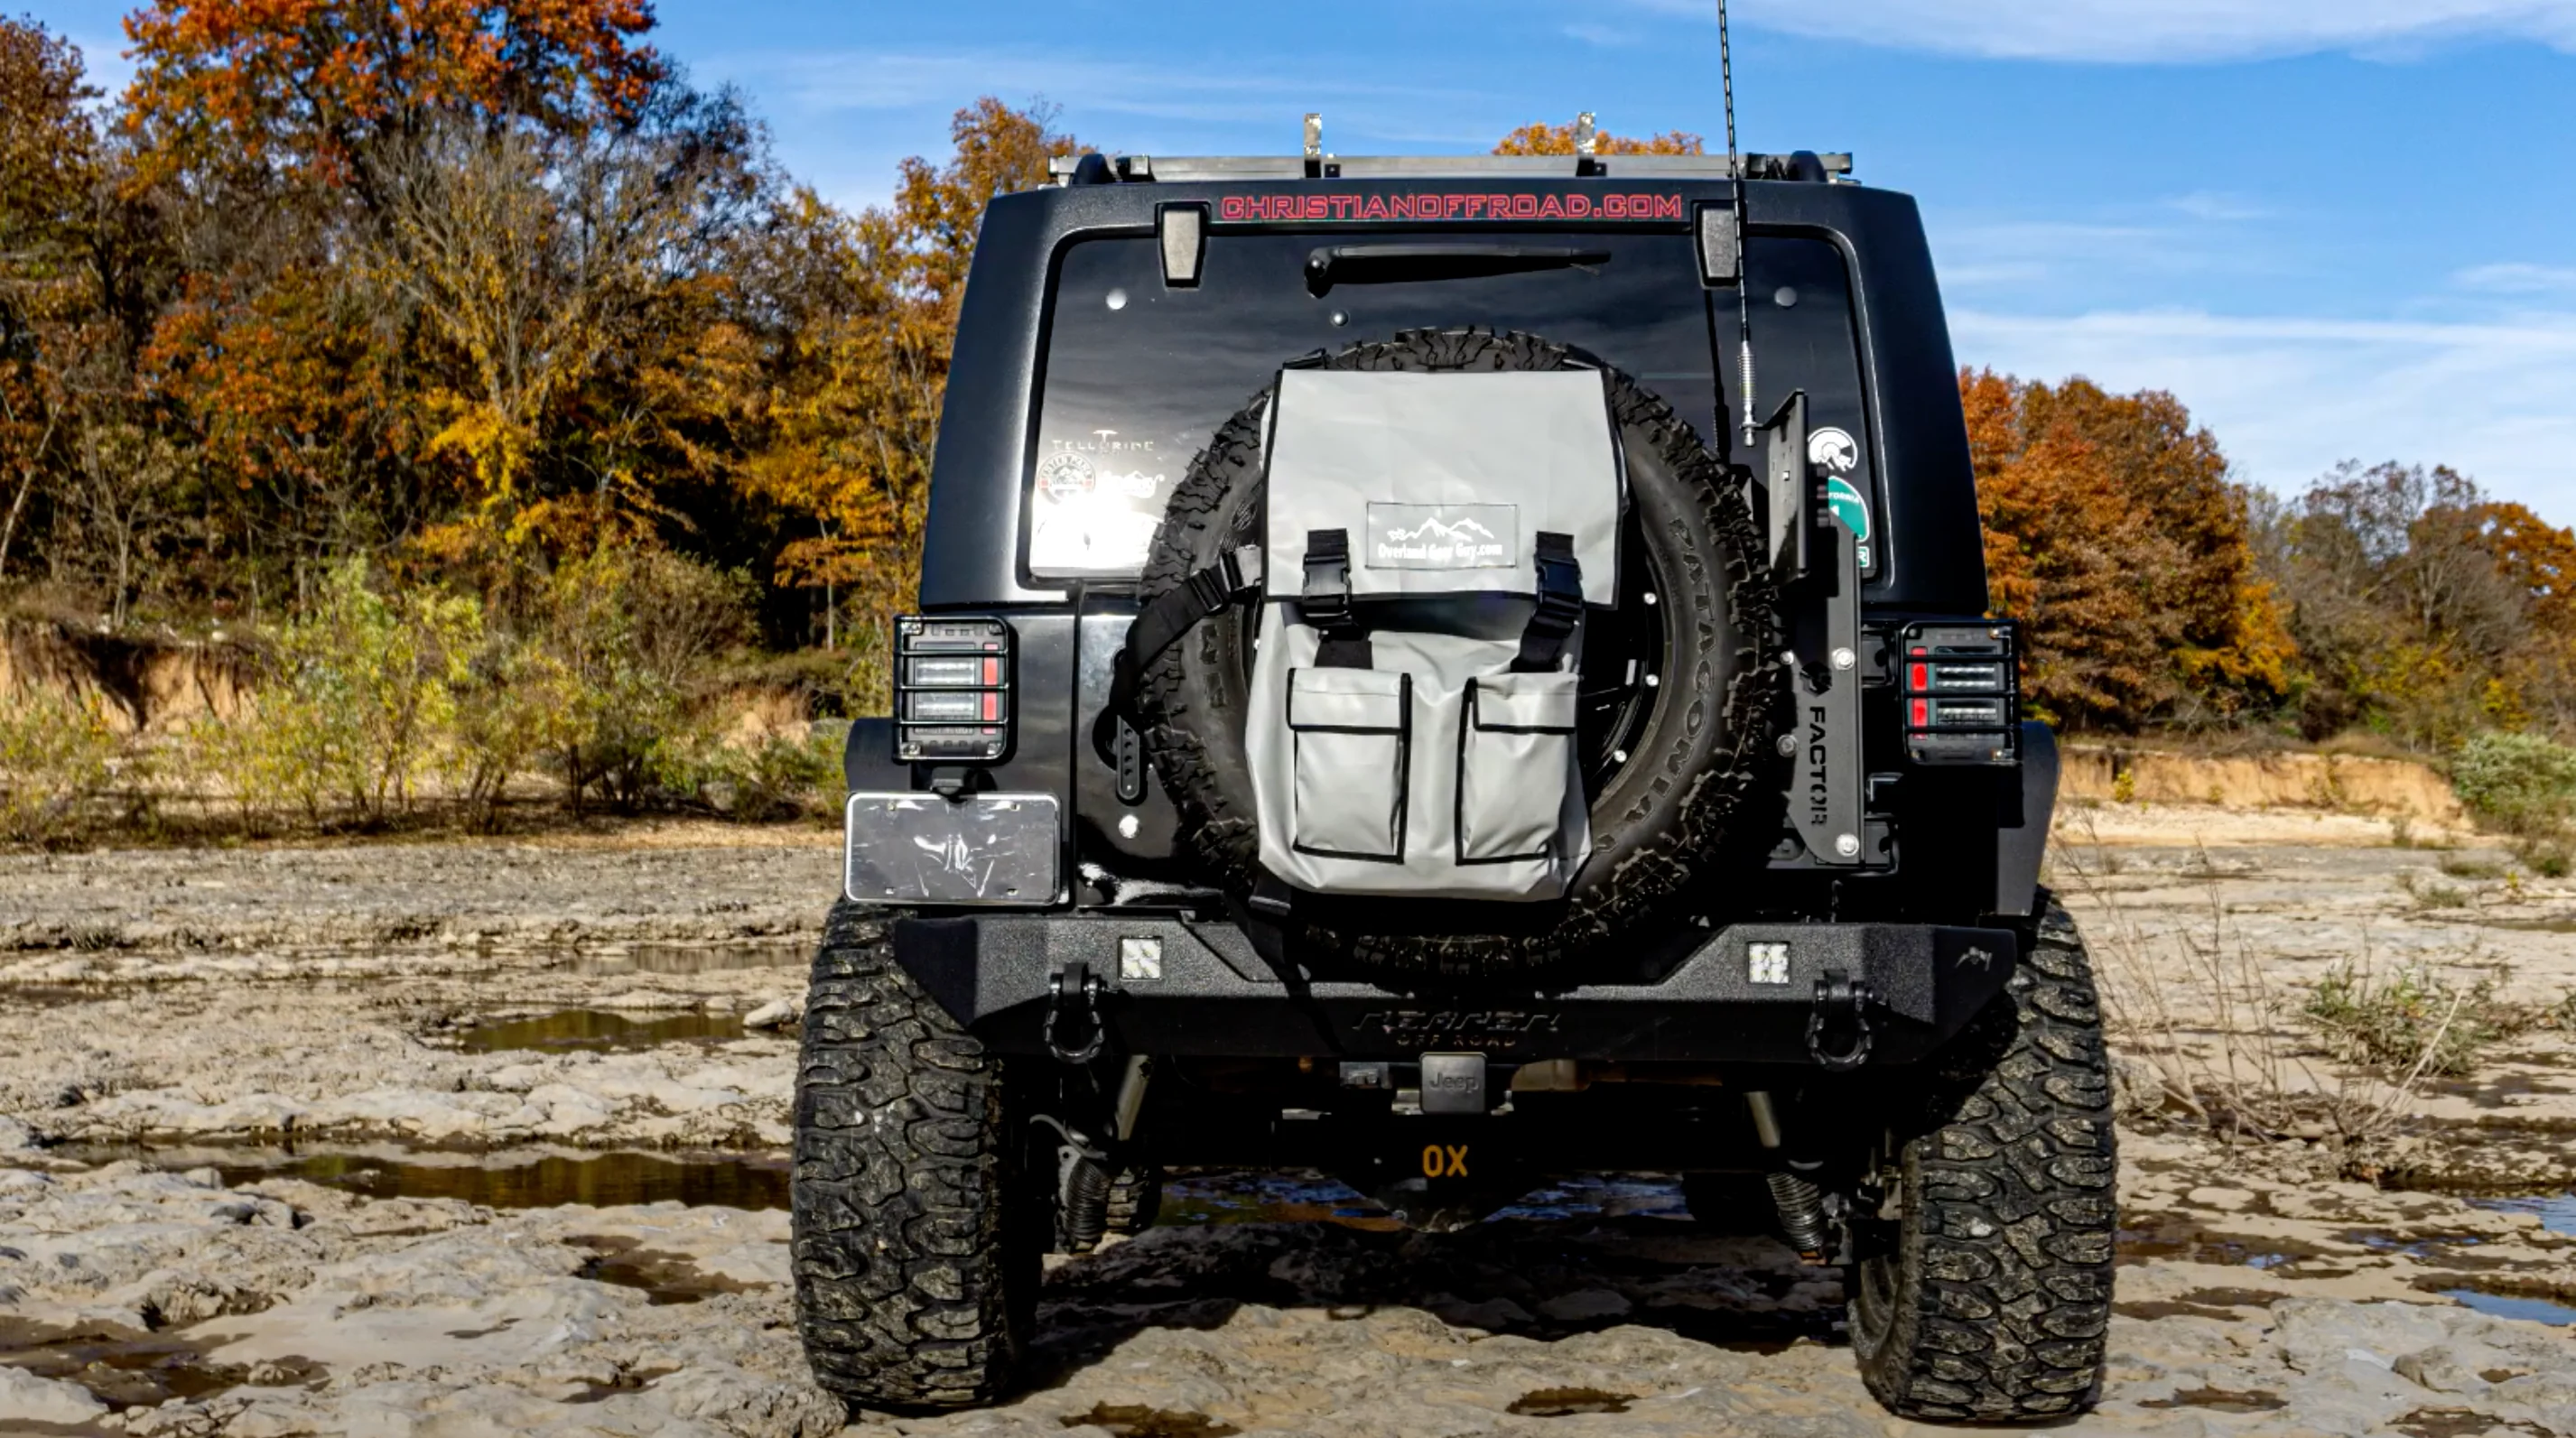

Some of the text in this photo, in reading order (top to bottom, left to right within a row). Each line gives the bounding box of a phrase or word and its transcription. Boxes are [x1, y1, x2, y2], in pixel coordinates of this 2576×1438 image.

[1221, 193, 1682, 219] CHRISTIANOFFROAD.COM
[1378, 543, 1427, 559] Overland
[1455, 542, 1502, 561] Guy.com
[1625, 518, 1716, 822] PATAGONIA
[1809, 706, 1827, 826] FACTOR
[1428, 1072, 1480, 1094] Jeep
[1423, 1144, 1468, 1177] OX
